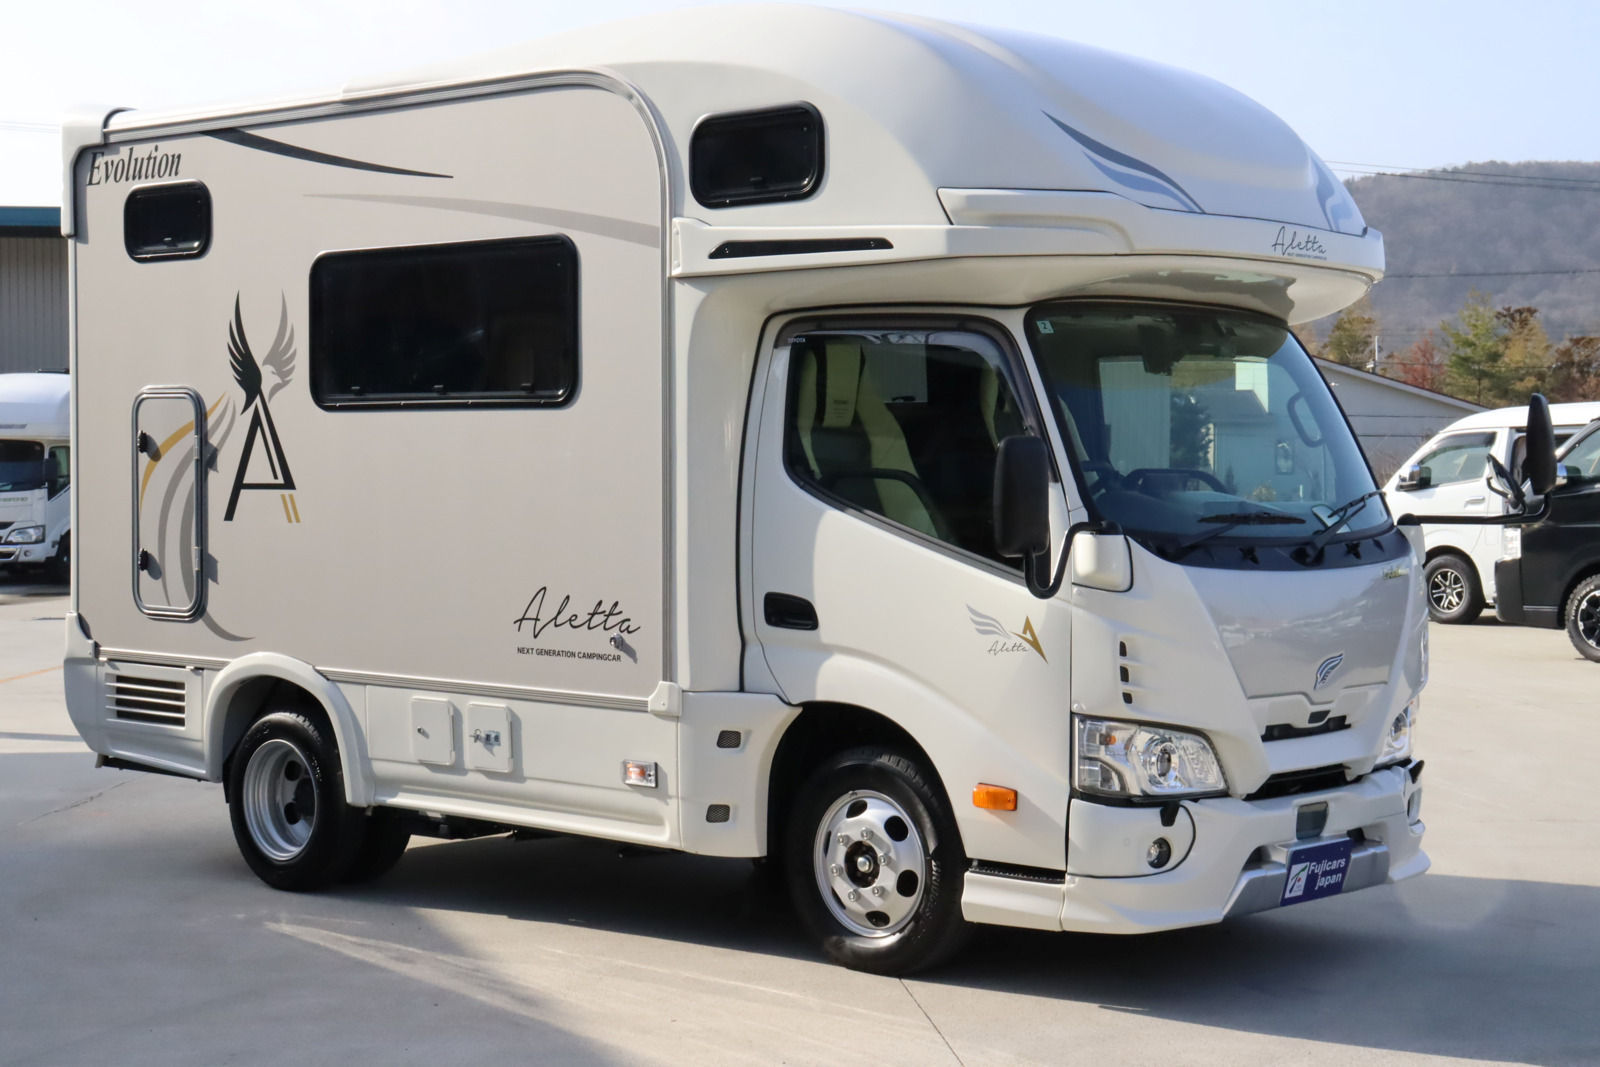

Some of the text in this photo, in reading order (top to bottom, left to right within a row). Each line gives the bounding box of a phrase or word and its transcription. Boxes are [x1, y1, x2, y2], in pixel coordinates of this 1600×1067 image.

[86, 144, 182, 187] Evolution
[1271, 225, 1327, 256] Aletta
[513, 586, 641, 639] Aletta
[517, 646, 622, 663] NEXT GENERATION CAMPINGCAR
[987, 640, 1029, 656] Aletta
[1308, 858, 1347, 875] Fujicars
[1314, 872, 1342, 891] japan
